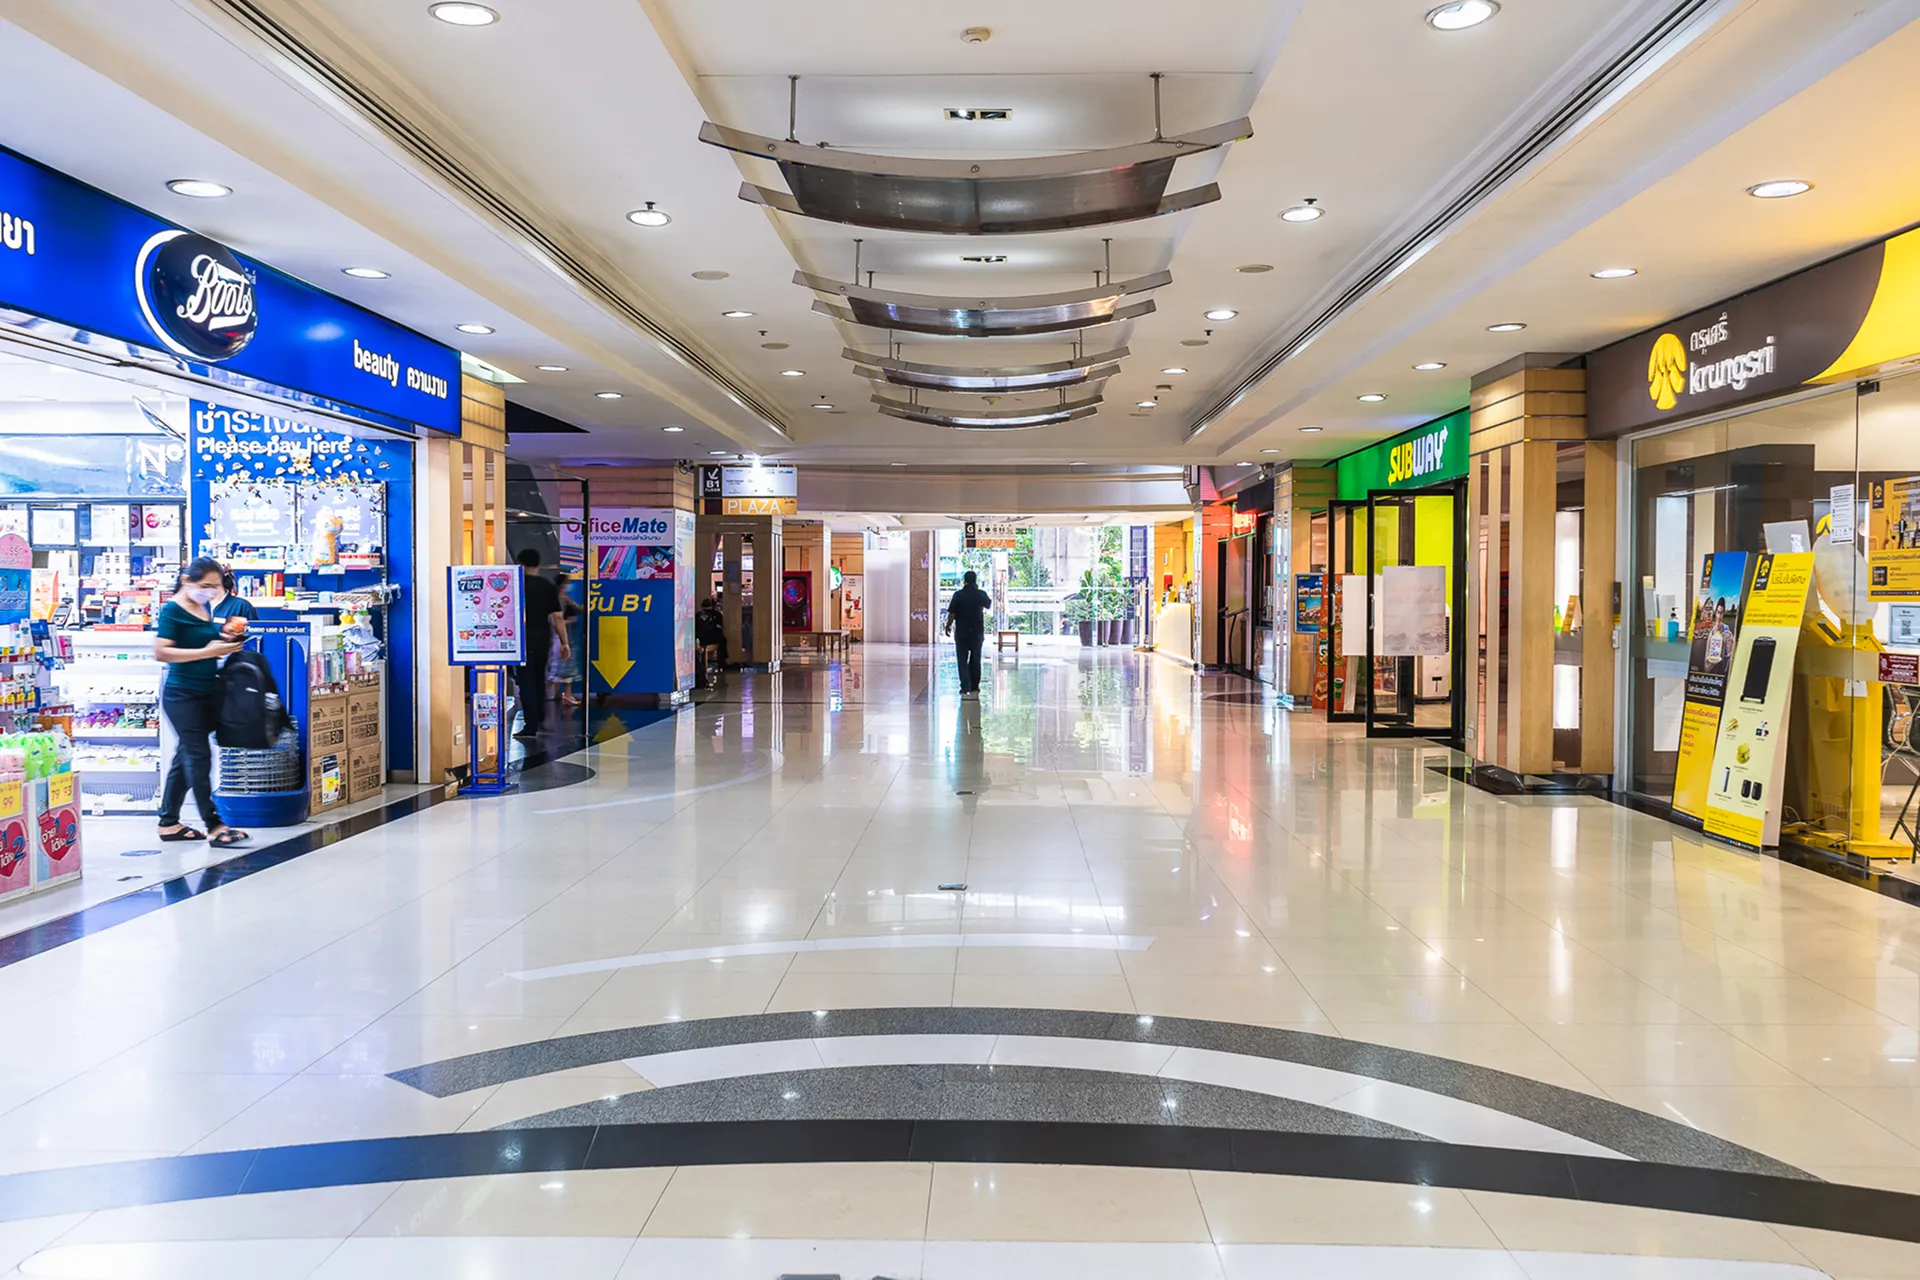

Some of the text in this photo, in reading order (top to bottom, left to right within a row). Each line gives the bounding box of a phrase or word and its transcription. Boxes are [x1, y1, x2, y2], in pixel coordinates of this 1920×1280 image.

[0, 211, 35, 255] ยา
[176, 254, 253, 331] Boots
[354, 338, 447, 400] beauty ความงาม
[1689, 335, 1776, 395] krungsri
[196, 436, 350, 457] Please pay here
[1387, 425, 1448, 487] SUBWAY
[706, 480, 720, 488] B1
[727, 499, 781, 515] PLAZA
[566, 517, 668, 533] OficeMate
[621, 594, 652, 612] B1
[65, 822, 76, 847] 2
[13, 836, 26, 861] 2
